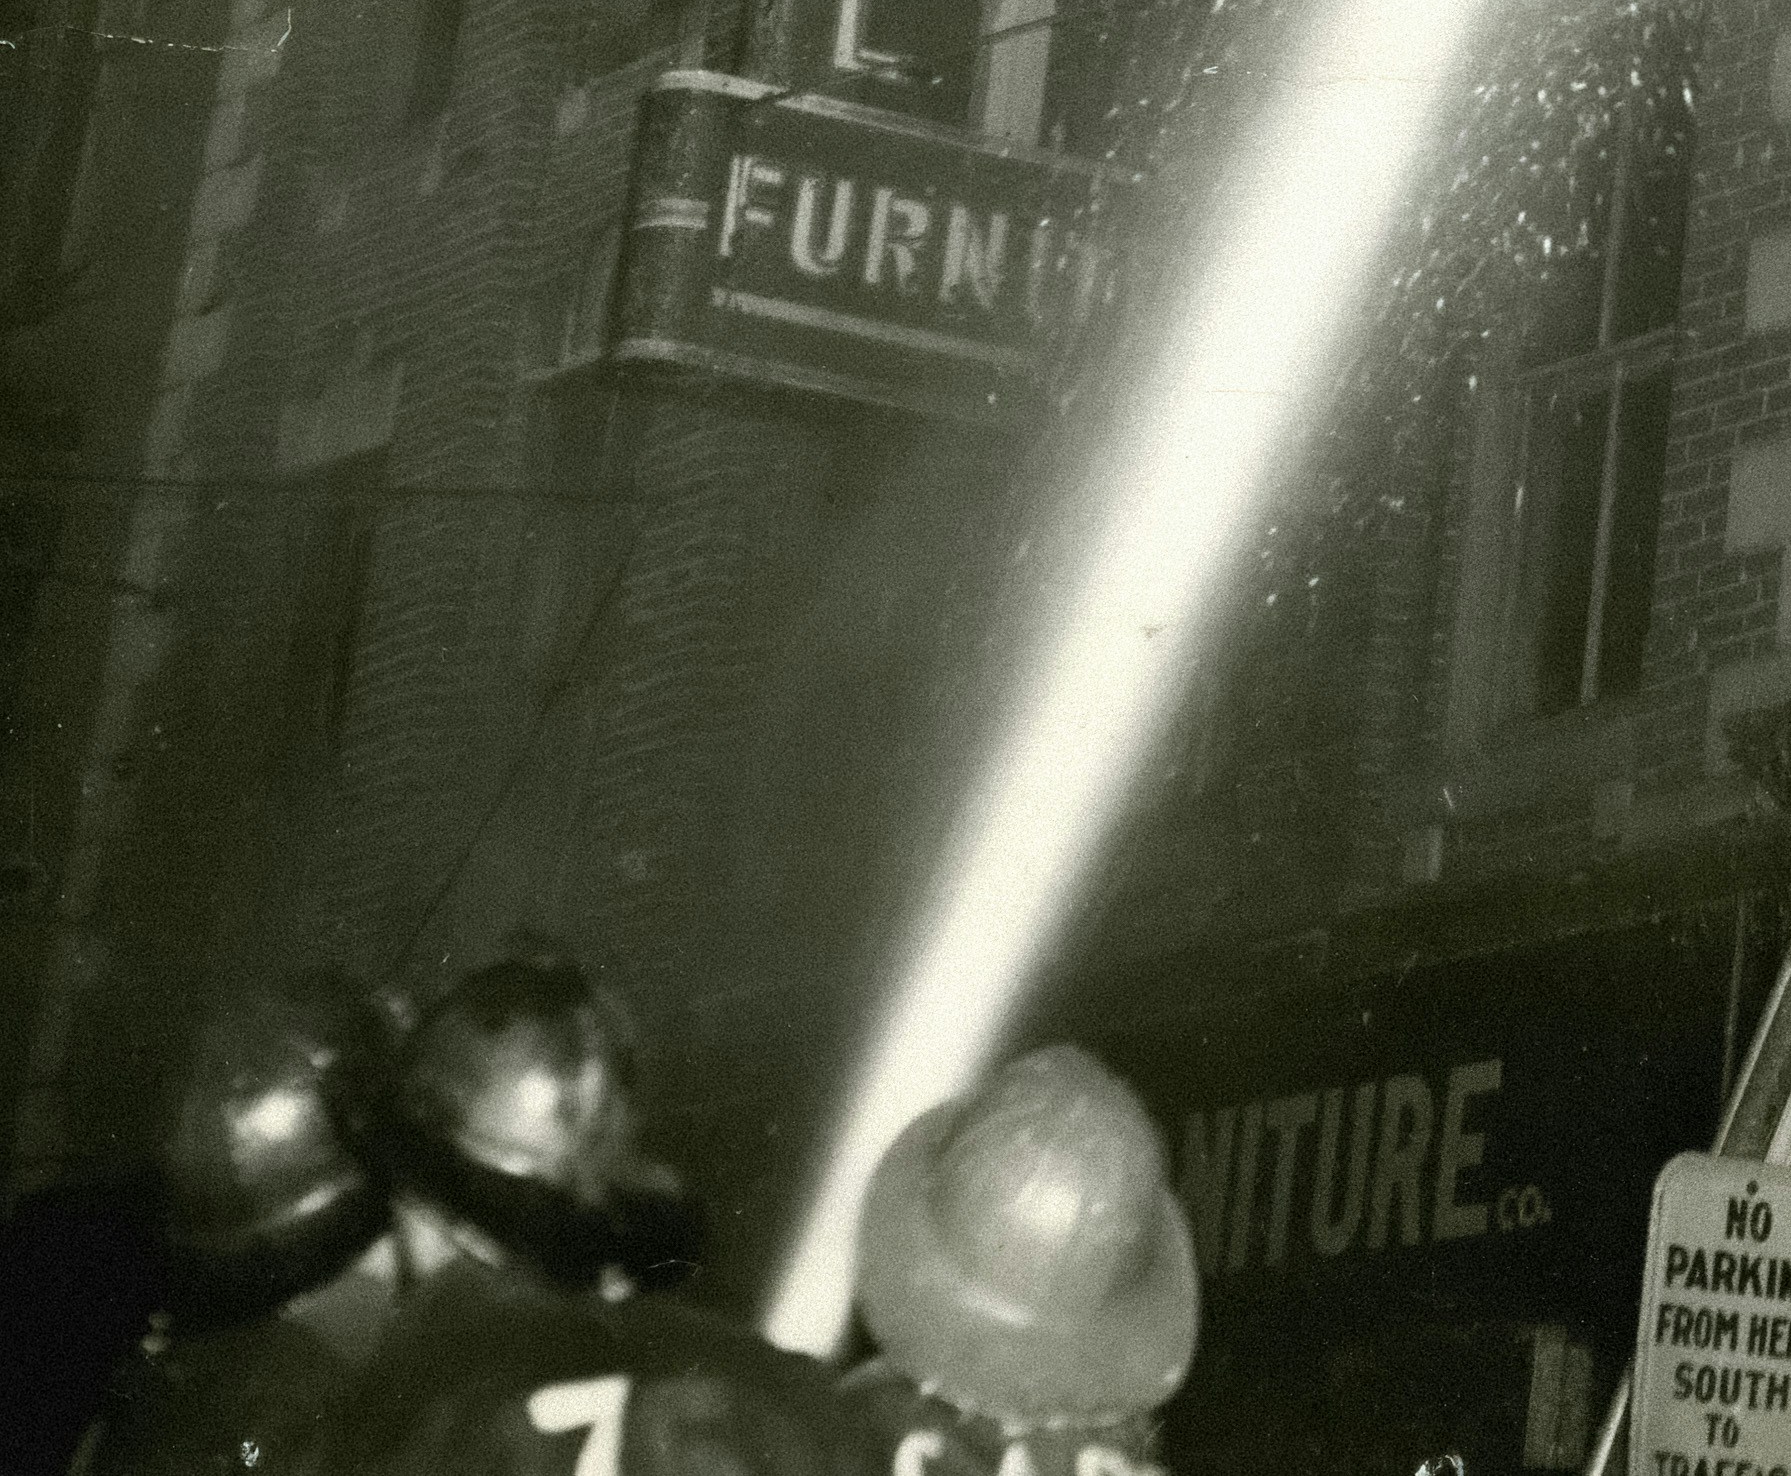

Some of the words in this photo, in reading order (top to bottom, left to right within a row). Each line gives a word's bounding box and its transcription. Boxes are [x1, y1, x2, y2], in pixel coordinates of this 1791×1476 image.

[1183, 1058, 1501, 1276] NITURE
[1725, 1197, 1773, 1243] NO
[1654, 1303, 1739, 1352] FROM
[1705, 1412, 1741, 1449] TO
